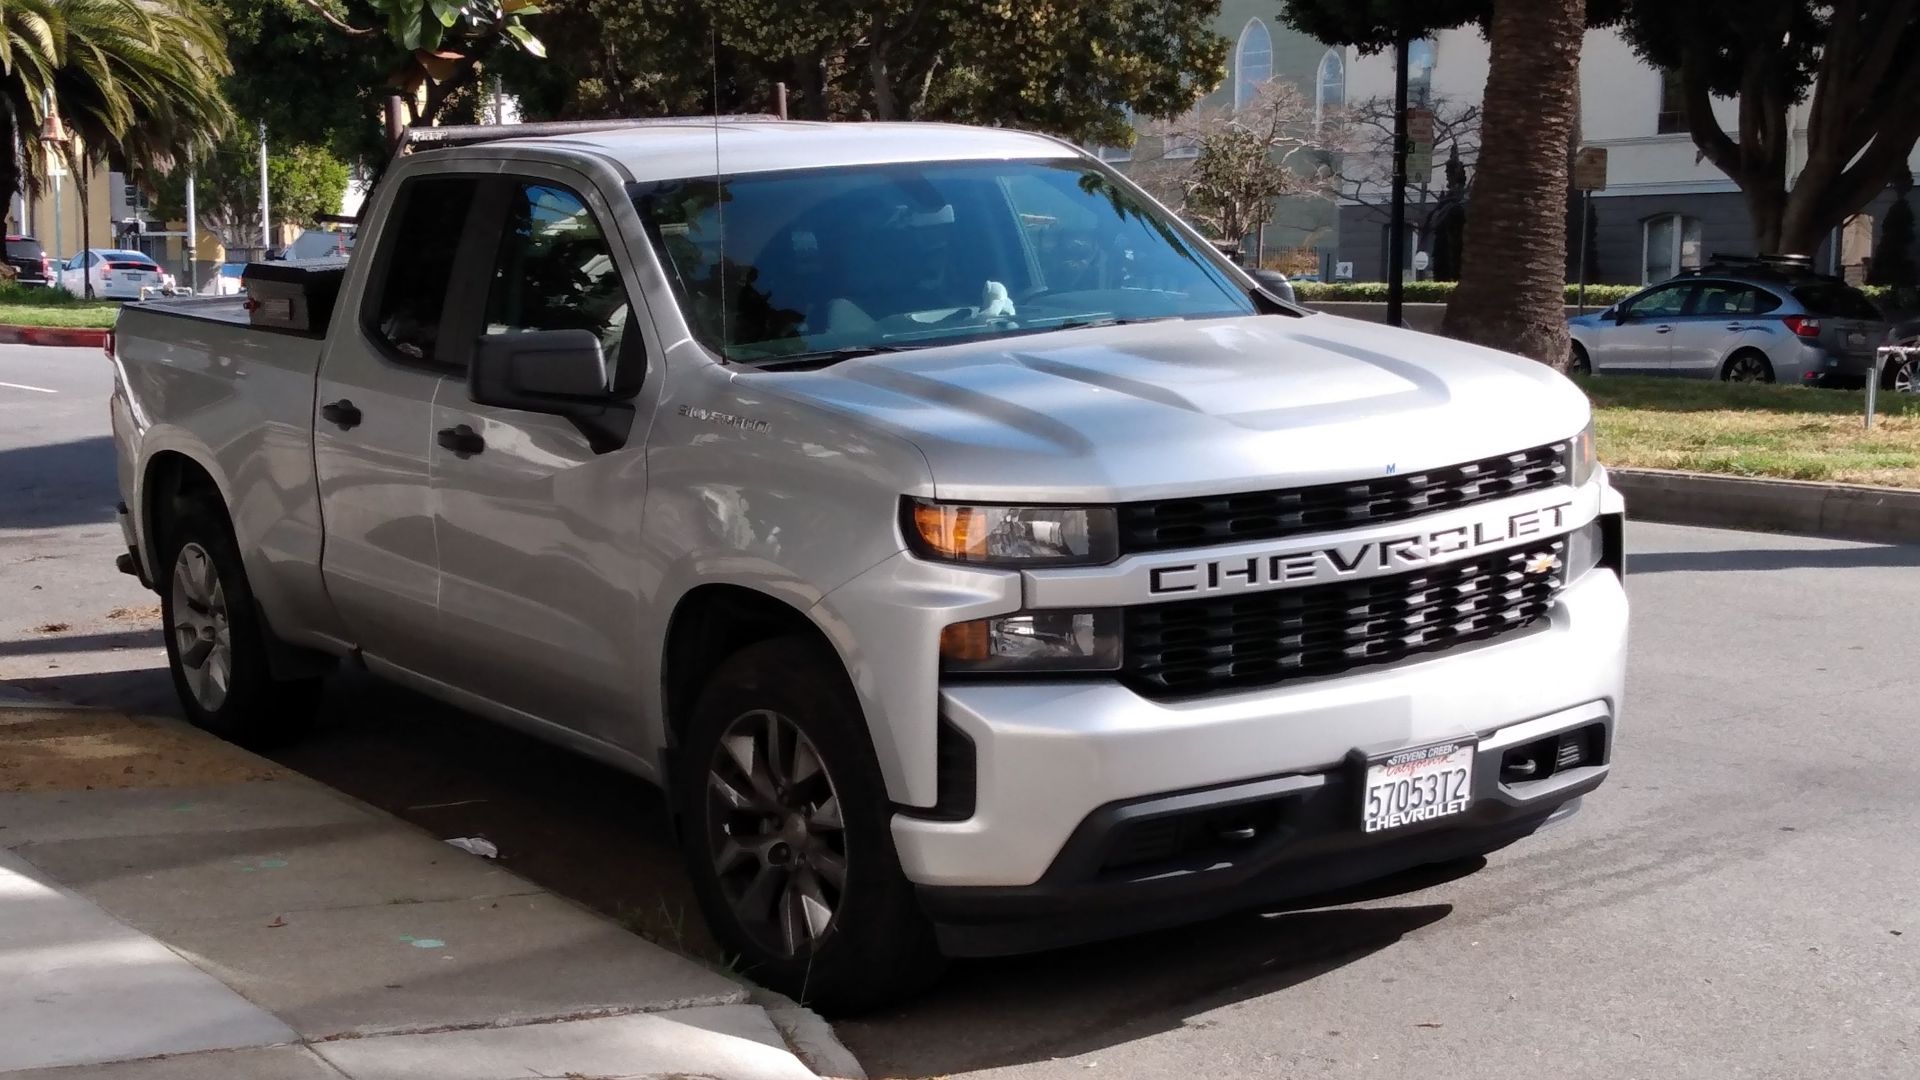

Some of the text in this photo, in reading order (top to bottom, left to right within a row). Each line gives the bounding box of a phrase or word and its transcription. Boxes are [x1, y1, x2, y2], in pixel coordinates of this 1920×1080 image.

[1386, 463, 1396, 474] M
[1150, 501, 1572, 595] CHEVROLET
[1390, 743, 1454, 766] STEVENS CREEK
[1369, 768, 1467, 818] 57053T2
[1365, 800, 1466, 833] CHEVROLET
